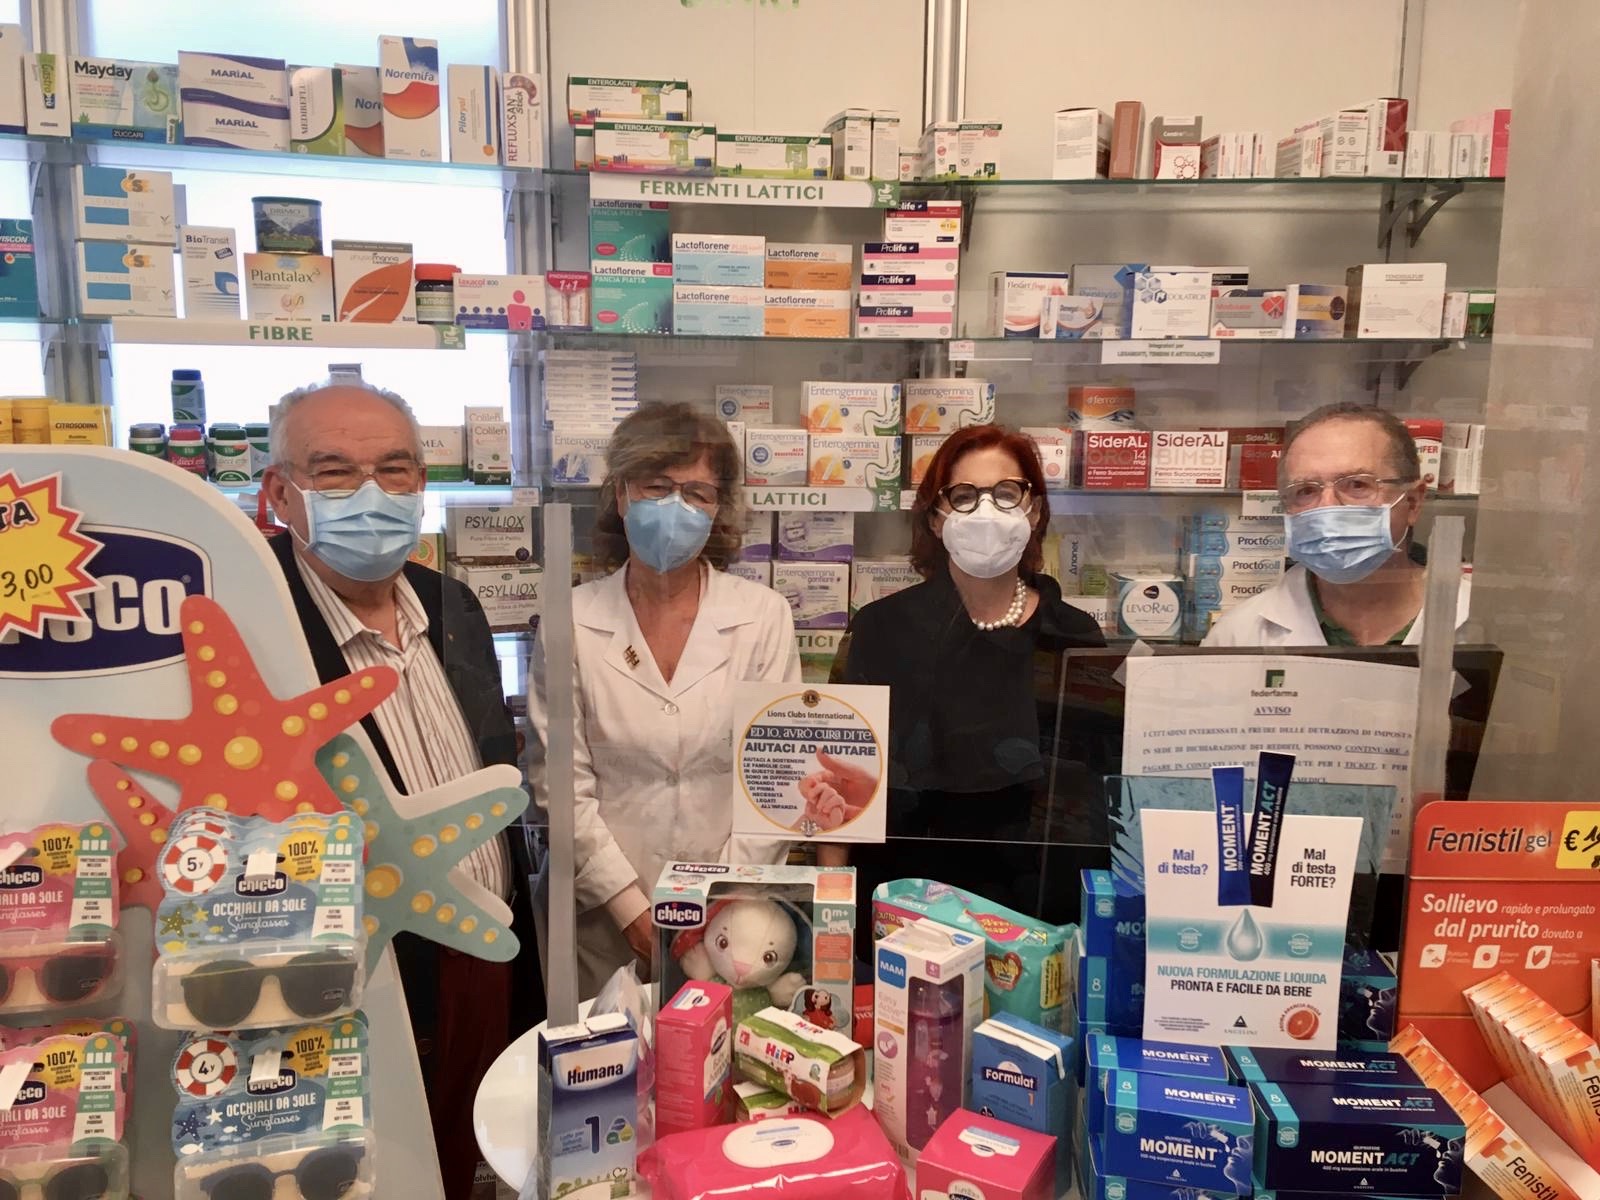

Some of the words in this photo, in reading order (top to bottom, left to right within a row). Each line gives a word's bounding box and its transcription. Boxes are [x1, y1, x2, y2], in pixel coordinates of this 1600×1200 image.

[74, 60, 133, 80] Mayday
[385, 68, 434, 82] Noremifa
[640, 180, 739, 198] FERMENTI
[746, 185, 824, 200] LATTICI
[185, 234, 230, 245] BioTransit
[675, 240, 730, 250] Lactoflorene
[768, 248, 819, 258] Lactoflorene
[880, 244, 907, 253] Prolife
[594, 266, 646, 276] Lactoflorene
[878, 275, 904, 284] Prolife
[676, 292, 730, 302] Lactoflorene
[764, 295, 816, 306] Lactoflorene
[875, 307, 902, 317] Prolife
[250, 325, 314, 341] FIBRE
[810, 385, 878, 398] Enterogermina
[908, 384, 974, 398] Enterogermina
[474, 425, 508, 436] Colilen
[812, 438, 880, 450] Enterogermina
[1088, 435, 1148, 448] SiderAL
[1157, 433, 1224, 448] SiderAL
[1134, 450, 1146, 460] 14
[1156, 449, 1224, 466] BIMBI
[752, 492, 827, 506] LATTICI
[464, 516, 526, 528] PSYLLIOX
[1232, 560, 1281, 570] Proctosoll
[776, 568, 836, 578] Enterogermina
[478, 583, 538, 598] PSYLLIOX
[1250, 690, 1298, 698] federfarma
[768, 710, 786, 718] Lions
[787, 711, 806, 719] Clubs
[808, 712, 854, 720] International
[1254, 706, 1292, 715] AVVISO
[744, 742, 795, 754] AIUTACI
[798, 744, 817, 754] AD
[821, 745, 876, 756] AIUTARE
[42, 836, 74, 852] 100%
[1221, 804, 1238, 872] MOMENT
[1250, 811, 1272, 876] MOMENT
[1427, 826, 1524, 852] Fenistil
[1525, 832, 1552, 853] gel
[288, 840, 319, 856] 100%
[1172, 849, 1194, 860] Mal
[1304, 848, 1326, 860] Mal
[1158, 858, 1168, 874] di
[1172, 862, 1208, 875] testa?
[1292, 862, 1303, 874] di
[1307, 863, 1336, 875] testa
[1290, 875, 1336, 889] FORTE?
[39, 890, 64, 904] SOLE
[213, 900, 262, 917] OCCHIALI
[282, 898, 307, 912] SOLE
[1421, 893, 1498, 914] Sollievo
[1501, 904, 1533, 916] rapido
[1535, 906, 1540, 914] e
[1542, 904, 1596, 918] prolungato
[657, 904, 700, 922] chicco
[228, 914, 290, 934] Sunglasses
[1434, 918, 1466, 938] dal
[1468, 919, 1540, 943] prurito
[1542, 929, 1575, 939] dovuto
[1576, 931, 1584, 939] a
[880, 960, 904, 977] MAM
[1158, 965, 1194, 978] NUOVA
[1196, 967, 1281, 982] FORMULAZIONE
[1284, 973, 1327, 985] LIQUIDA
[1092, 979, 1101, 991] 8
[1171, 980, 1214, 992] PRONTA
[1217, 982, 1223, 992] E
[1226, 983, 1263, 994] FACILE
[1266, 984, 1280, 996] DA
[1283, 985, 1312, 997] BERE
[296, 1036, 326, 1054] 100%
[46, 1050, 78, 1067] 100%
[765, 1042, 795, 1064] HiPP
[1142, 1049, 1210, 1063] MOMENT
[198, 1060, 209, 1076] 4
[1300, 1060, 1365, 1070] MOMENT
[568, 1064, 624, 1086] Humana
[986, 1068, 1035, 1089] Formulat
[1028, 1092, 1034, 1105] 1
[1164, 1088, 1236, 1104] MOMENT
[1332, 1097, 1400, 1108] MOMENT
[226, 1099, 274, 1118] OCCHIALI
[292, 1092, 316, 1109] SOLE
[42, 1106, 67, 1120] SOLE
[240, 1112, 301, 1132] Sunglasses
[585, 1116, 600, 1154] 1
[1140, 1138, 1218, 1161] MOMENT
[1310, 1150, 1384, 1164] MOMENT
[1384, 1152, 1420, 1166] ACT
